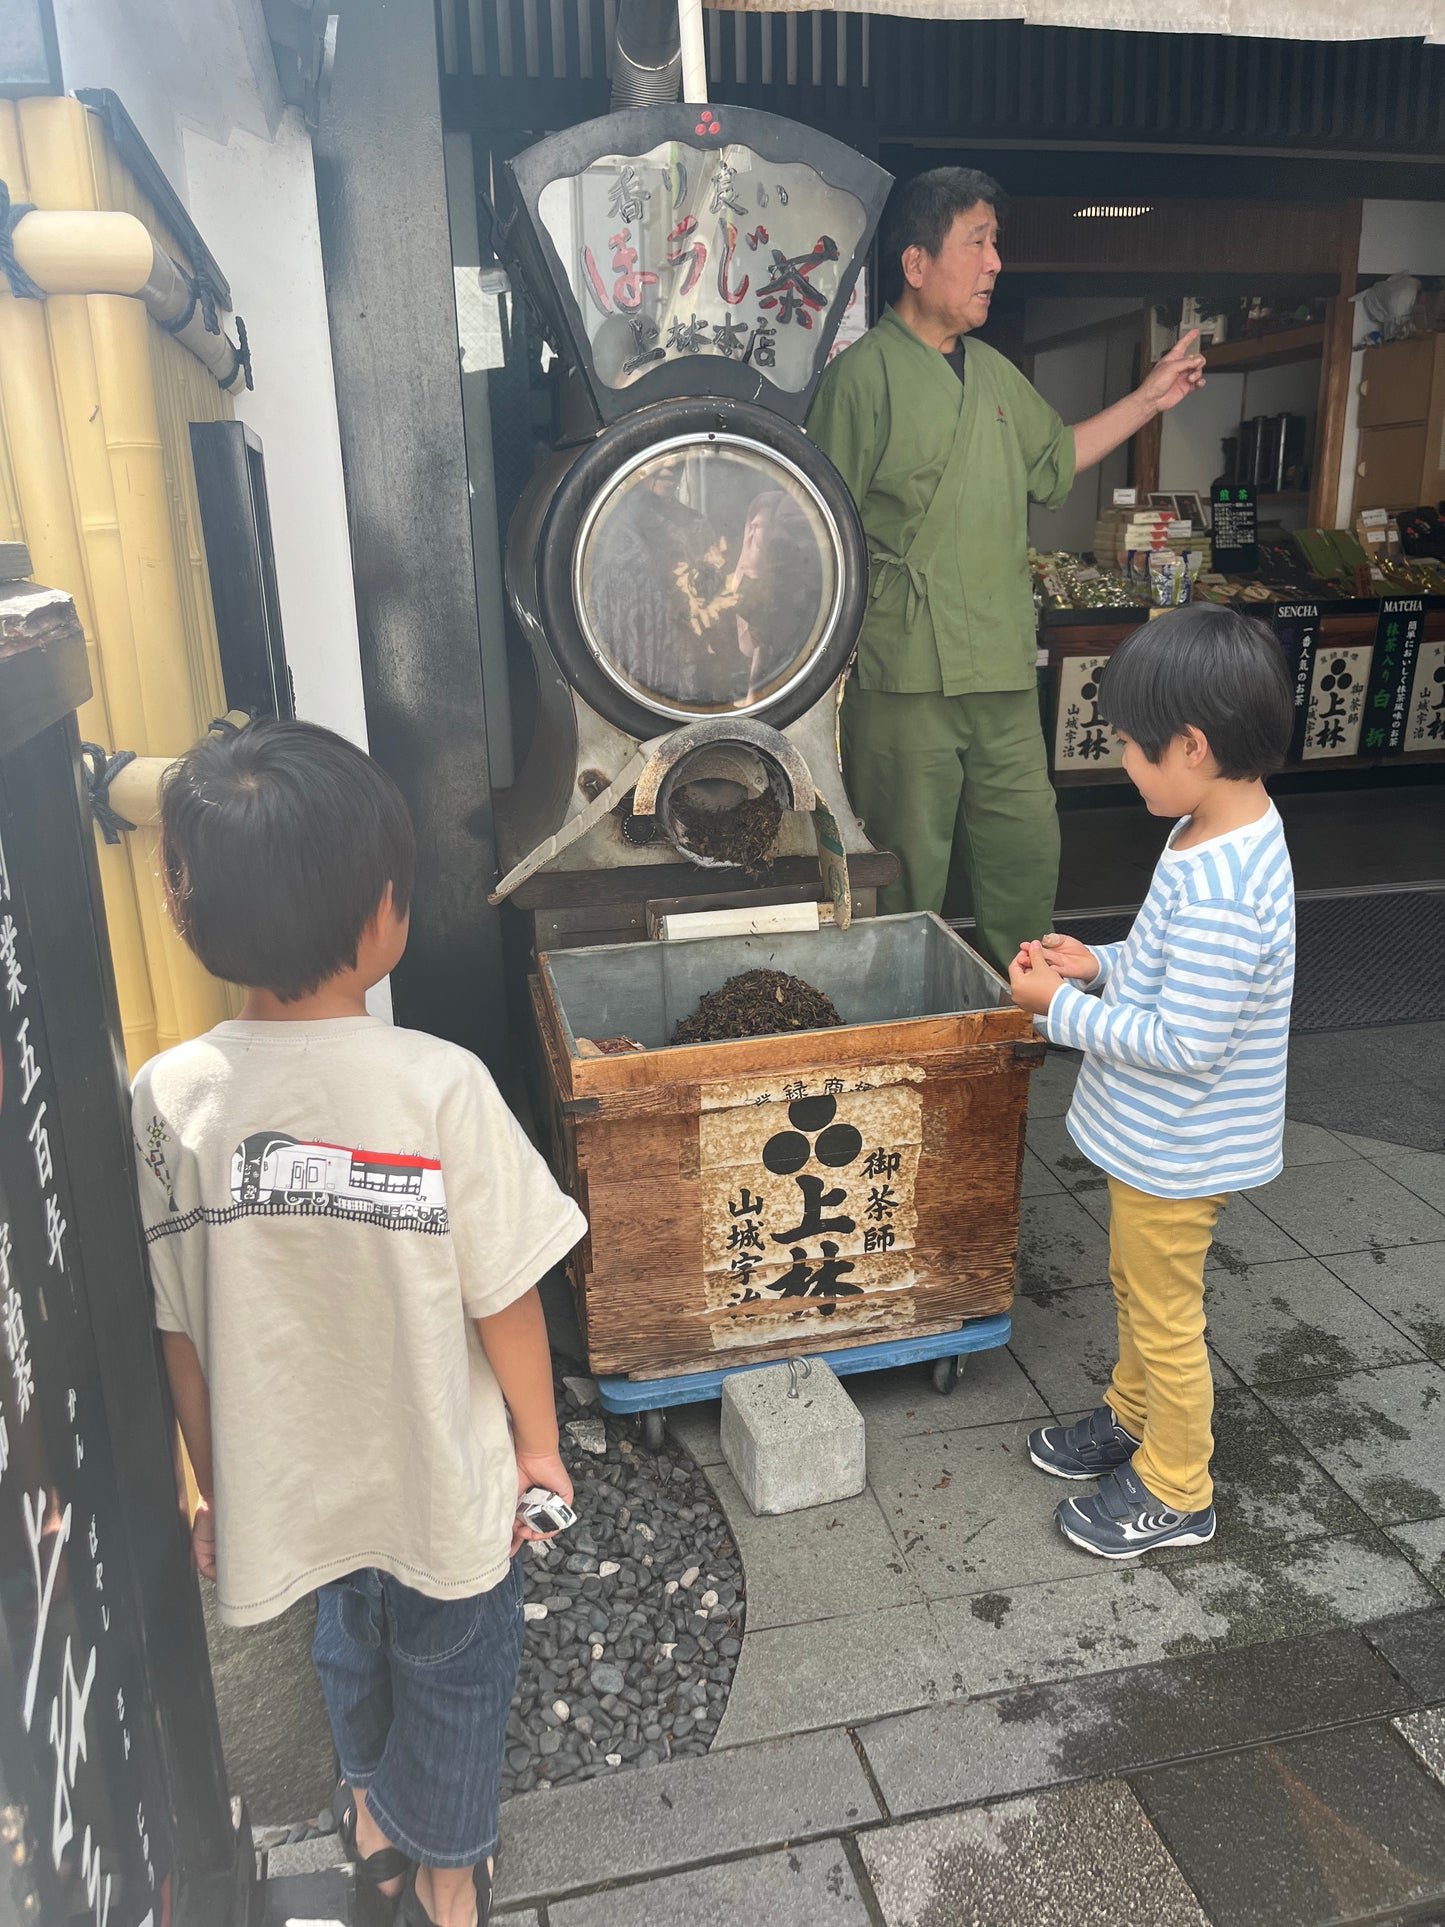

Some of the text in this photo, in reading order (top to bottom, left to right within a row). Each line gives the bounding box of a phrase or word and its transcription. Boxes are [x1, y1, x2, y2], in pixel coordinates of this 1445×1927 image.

[581, 214, 840, 329] ほうじ茶
[622, 312, 776, 376] 上林本店
[1277, 605, 1318, 618] SENCHA
[1383, 600, 1423, 613] MATCHA
[1295, 627, 1314, 706] 一番人気のお茶
[1062, 704, 1080, 758] 山城宇治
[1315, 691, 1347, 748] 上林
[0, 831, 67, 1273] 業五百年
[860, 1147, 901, 1253] 御茶師
[766, 1174, 865, 1317] 上林
